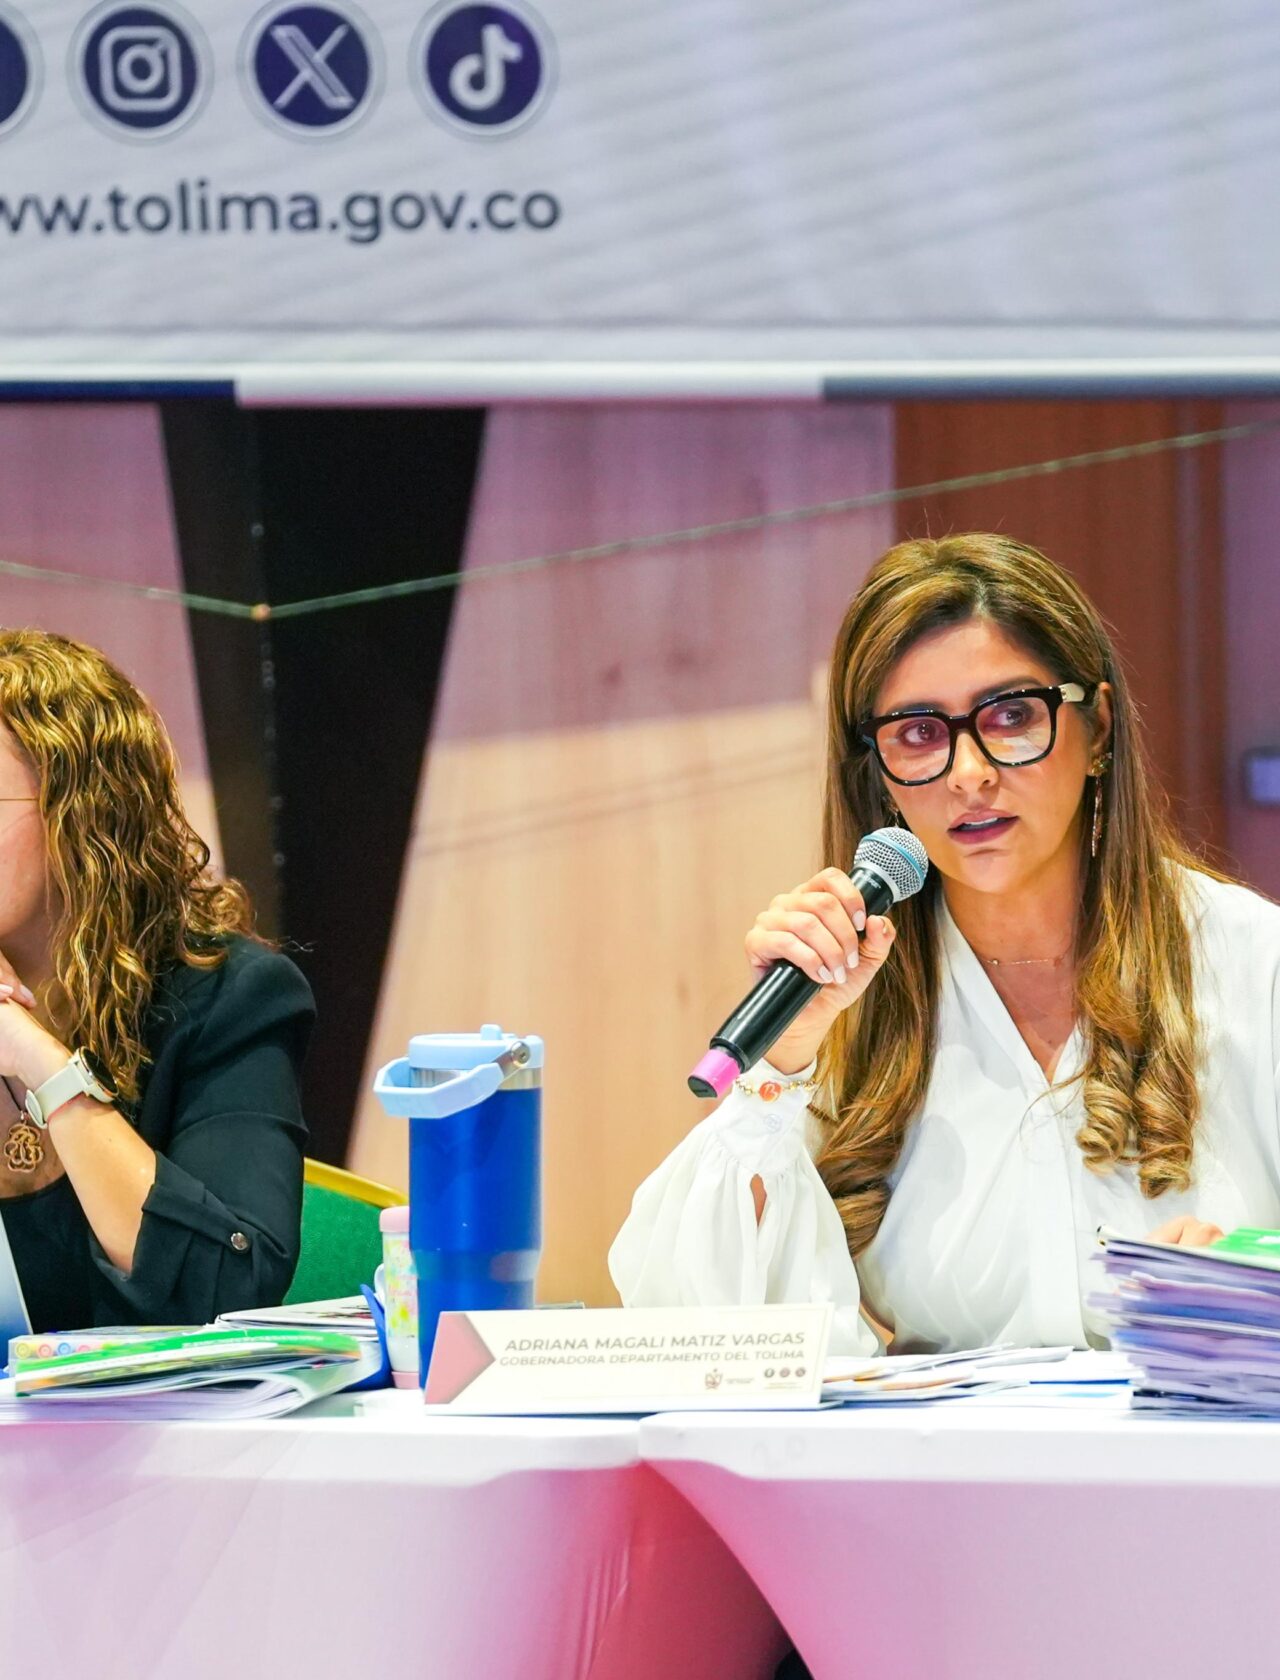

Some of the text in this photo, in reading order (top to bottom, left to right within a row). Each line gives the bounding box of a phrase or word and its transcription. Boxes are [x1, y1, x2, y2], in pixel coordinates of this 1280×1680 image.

[505, 1332, 805, 1351] ADRIANA MAGALI MATIZ VARGAS
[499, 1350, 805, 1366] GOBERNADORA DEPARTAMENTO DEL TOLIMA
